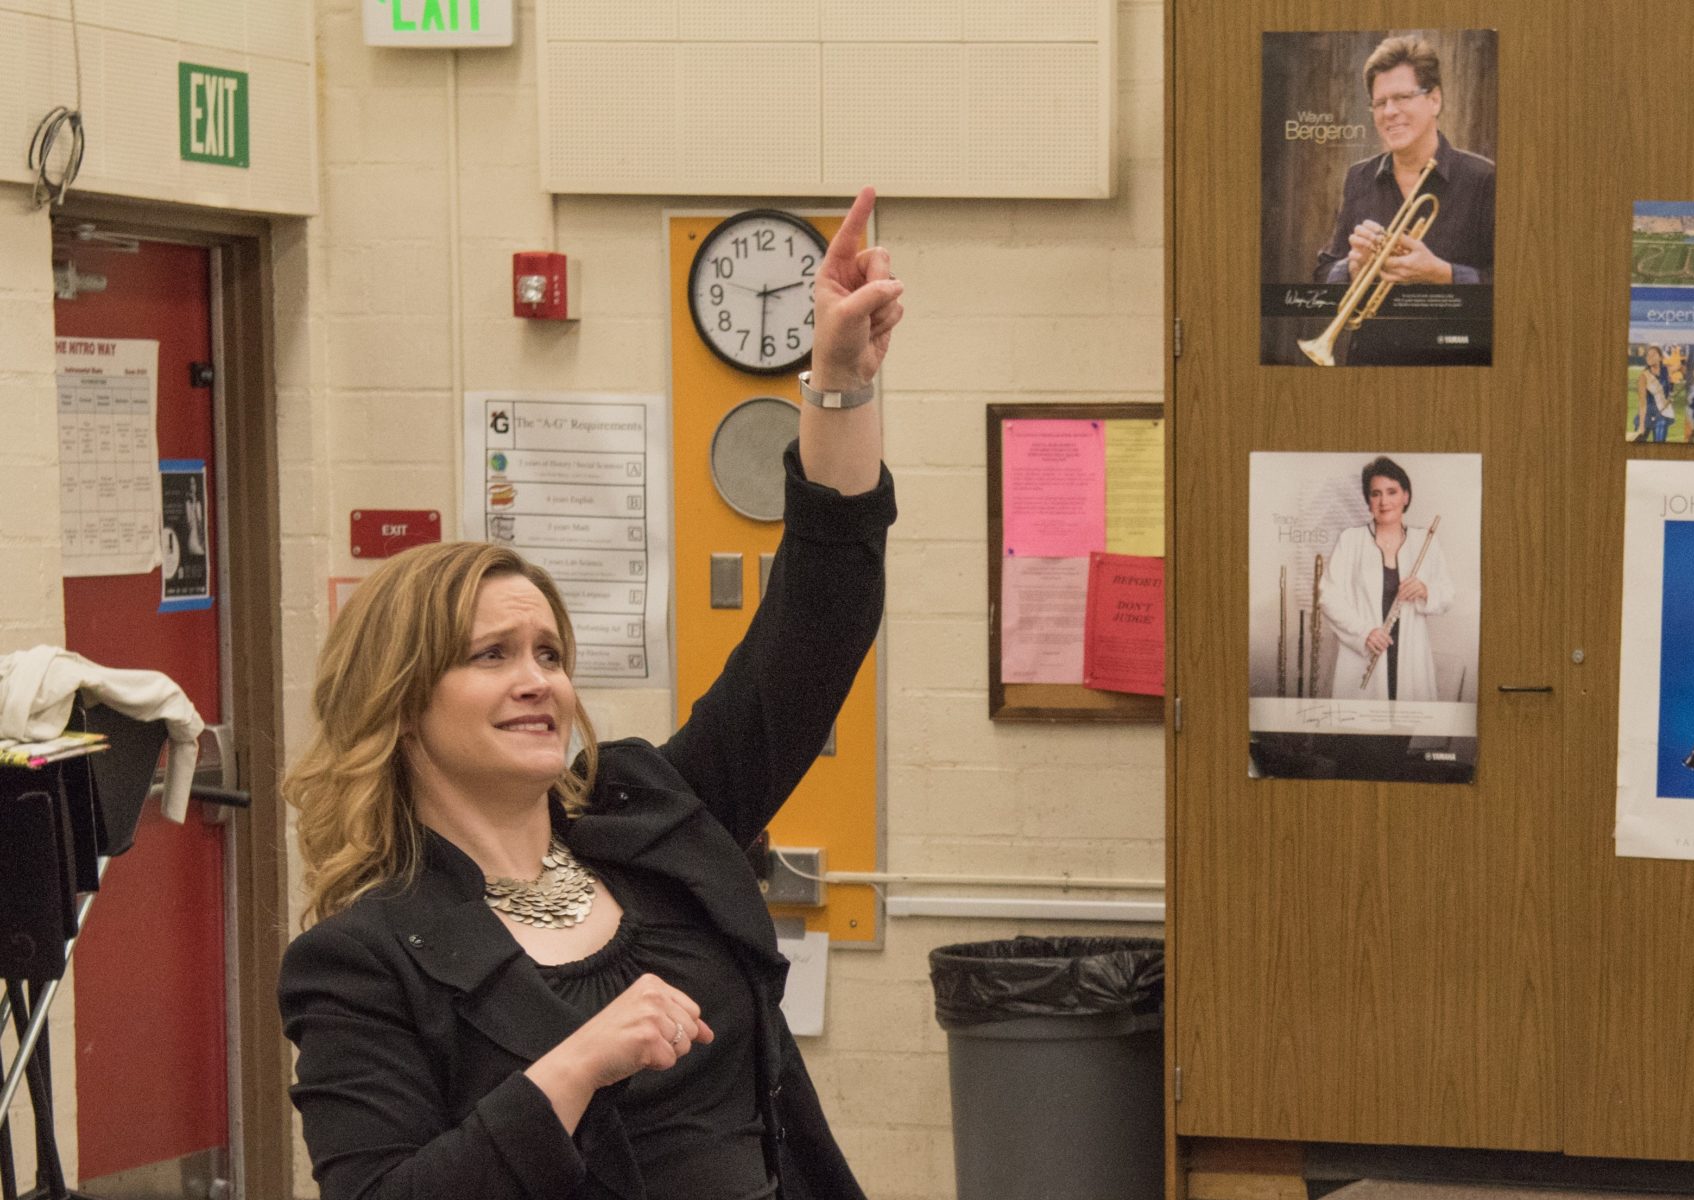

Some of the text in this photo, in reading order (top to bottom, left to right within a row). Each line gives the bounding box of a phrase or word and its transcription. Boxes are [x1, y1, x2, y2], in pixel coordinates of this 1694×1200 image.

[190, 71, 238, 158] EXIT
[1285, 120, 1366, 145] Bergeron
[731, 237, 748, 259] 11
[752, 229, 776, 251] 12
[784, 236, 794, 258] 1
[710, 256, 734, 279] 10
[800, 255, 816, 277] 2
[709, 284, 724, 306] 9
[718, 310, 732, 332] 8
[96, 343, 116, 356] WAY
[736, 330, 750, 351] 7
[762, 335, 776, 357] 6
[786, 328, 801, 350] 5
[517, 417, 534, 428] The
[571, 419, 642, 433] Requirements
[381, 524, 408, 536] EXIT
[1278, 525, 1329, 544] Harris
